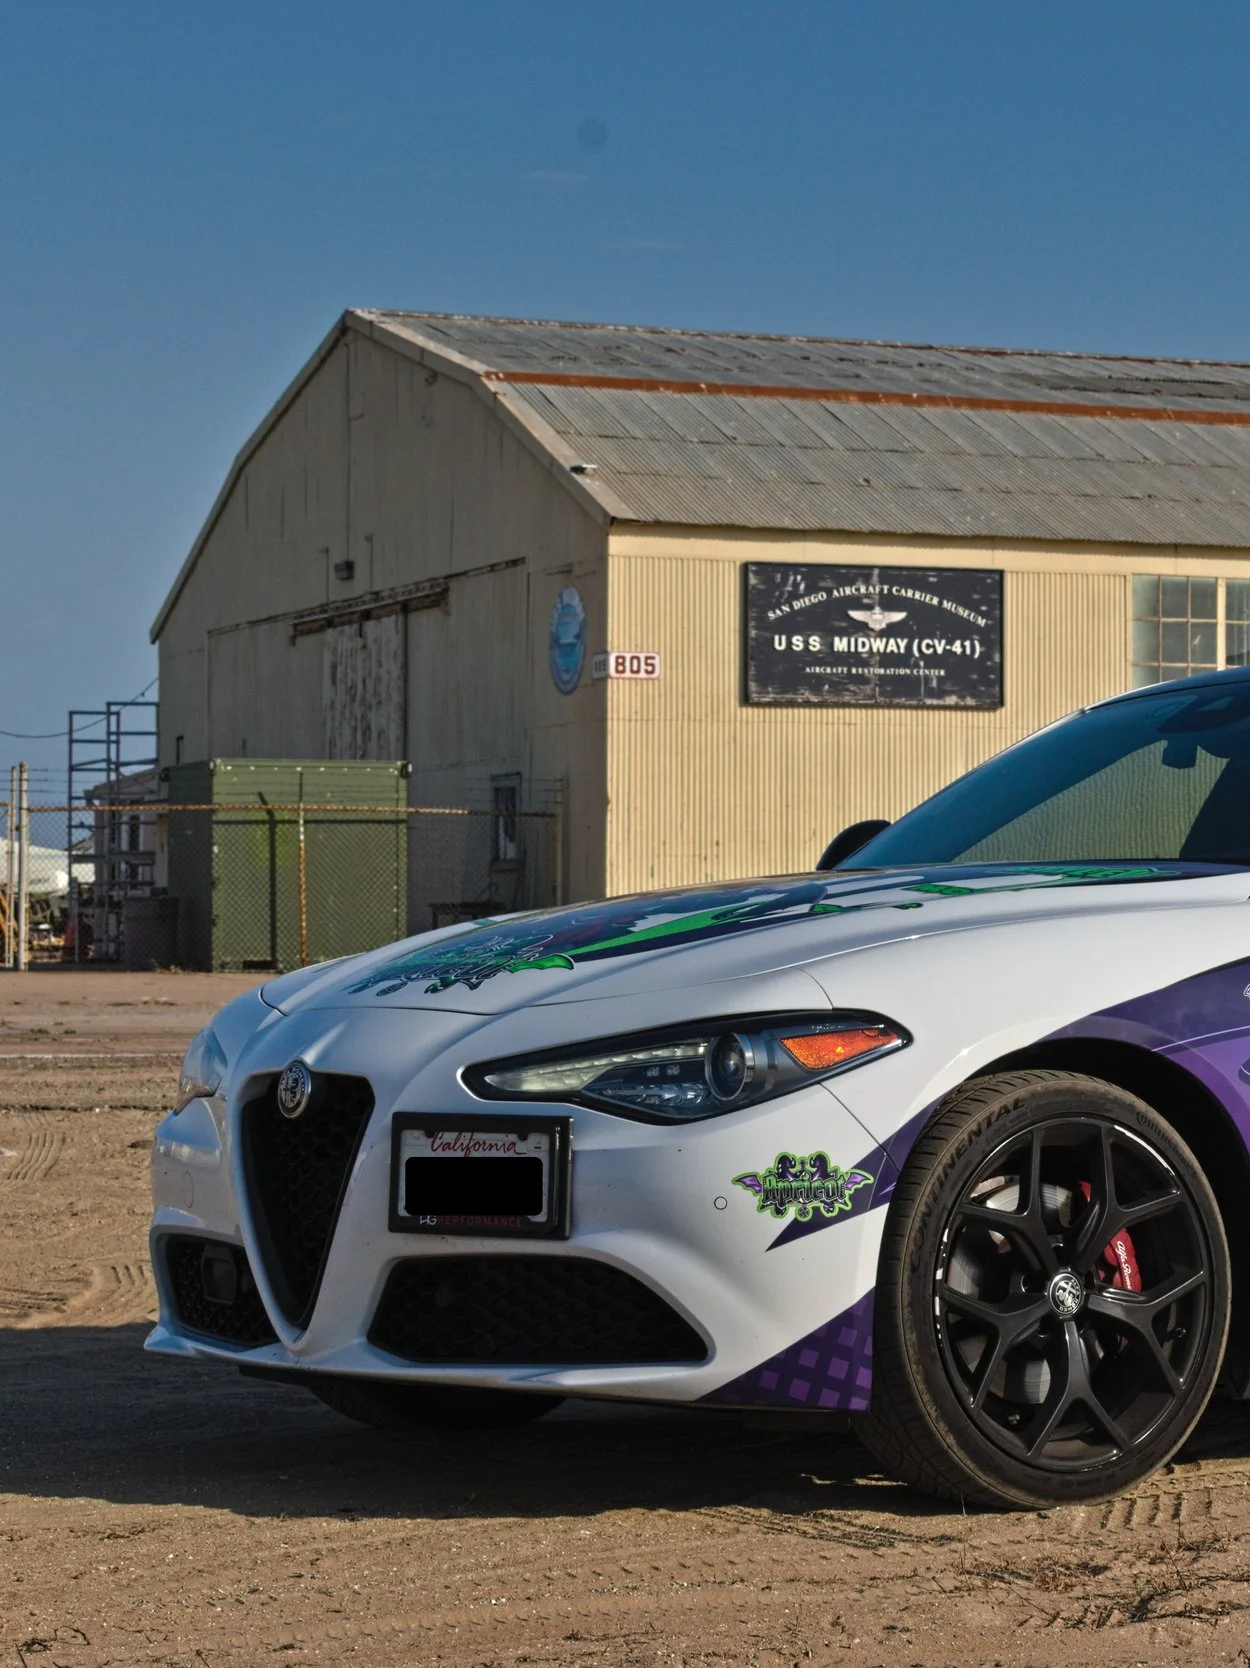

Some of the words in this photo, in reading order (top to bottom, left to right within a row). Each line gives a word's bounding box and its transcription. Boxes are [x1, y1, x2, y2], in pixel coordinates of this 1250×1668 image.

[767, 604, 791, 620] SAN
[794, 591, 828, 611] DIEGO
[832, 585, 890, 599] AIRCRAFT
[892, 586, 939, 605] CARRIER
[942, 599, 988, 627] MUSEUM
[833, 636, 909, 655] MIDWAY
[912, 638, 981, 659] (CV-41)
[614, 655, 656, 675] 805
[805, 665, 849, 675] AIRCRAFT
[851, 666, 911, 676] RESTORATION
[913, 667, 946, 677] CENTER
[430, 1131, 527, 1157] California
[762, 1172, 847, 1209] Apricot
[438, 1215, 523, 1228] PERFORMANCE
[1115, 1240, 1128, 1262] Alfa
[1122, 1263, 1132, 1291] Rome
